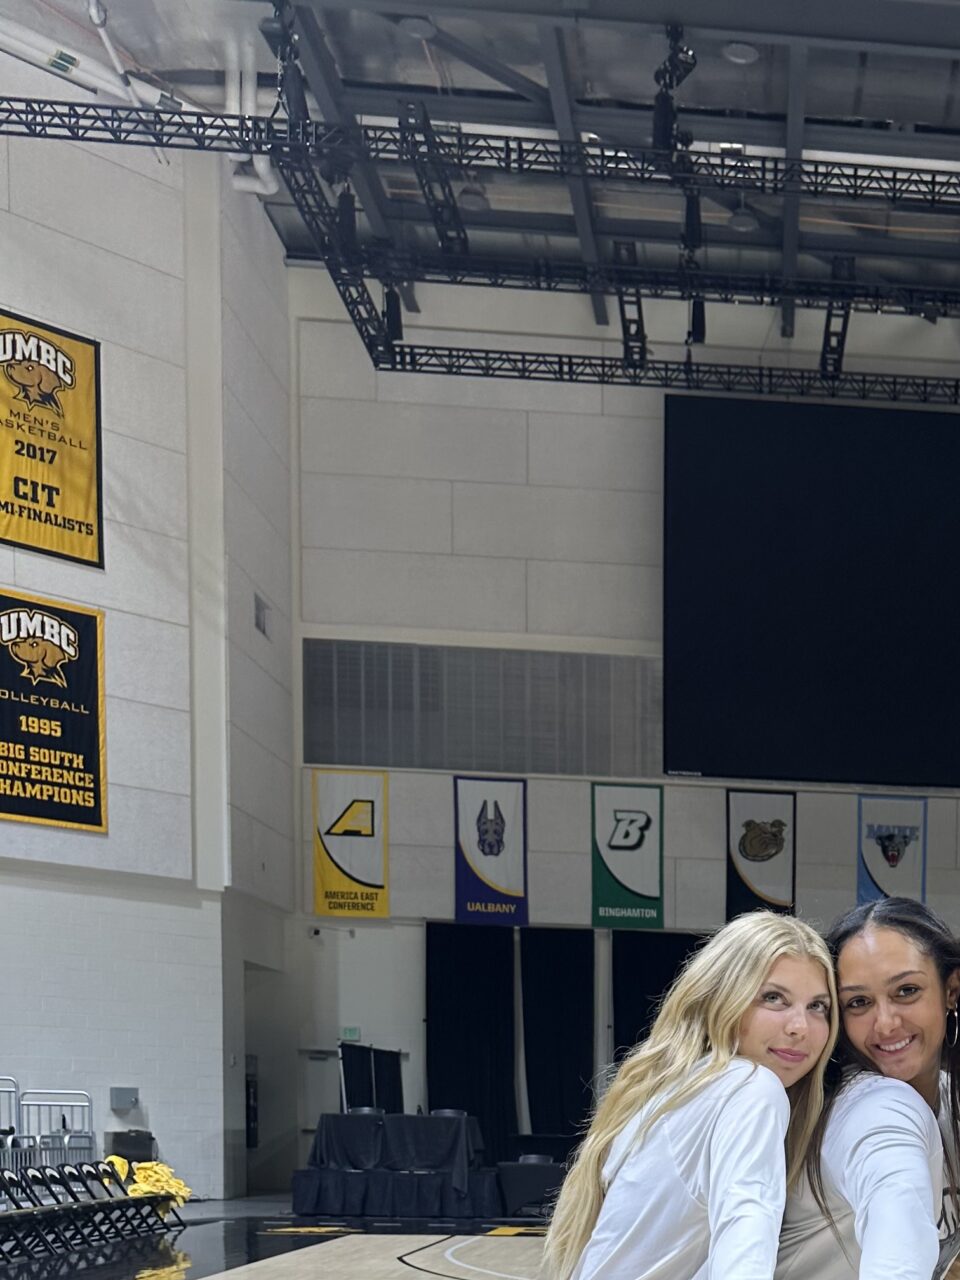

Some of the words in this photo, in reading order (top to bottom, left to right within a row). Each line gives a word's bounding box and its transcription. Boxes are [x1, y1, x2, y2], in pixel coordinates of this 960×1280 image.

[10, 409, 60, 431] MEN'S
[0, 419, 87, 450] SKETBALL
[15, 440, 57, 465] 2017
[13, 476, 60, 508] CIT
[0, 502, 94, 536] MI-FINALISTS
[1, 611, 76, 657] UMBC
[0, 689, 90, 714] OLLEYBALL
[19, 715, 62, 737] 1995
[0, 741, 25, 760] BIG
[30, 746, 84, 769] SOUTH
[0, 761, 94, 788] ONFERENCE
[0, 778, 95, 807] HAMPIONS
[608, 809, 653, 851] B
[324, 891, 359, 901] AMERICA
[361, 892, 379, 902] EAST
[328, 901, 375, 911] CONFERENCE
[467, 902, 517, 914] UALBANY
[599, 906, 657, 918] BINGHAMTON
